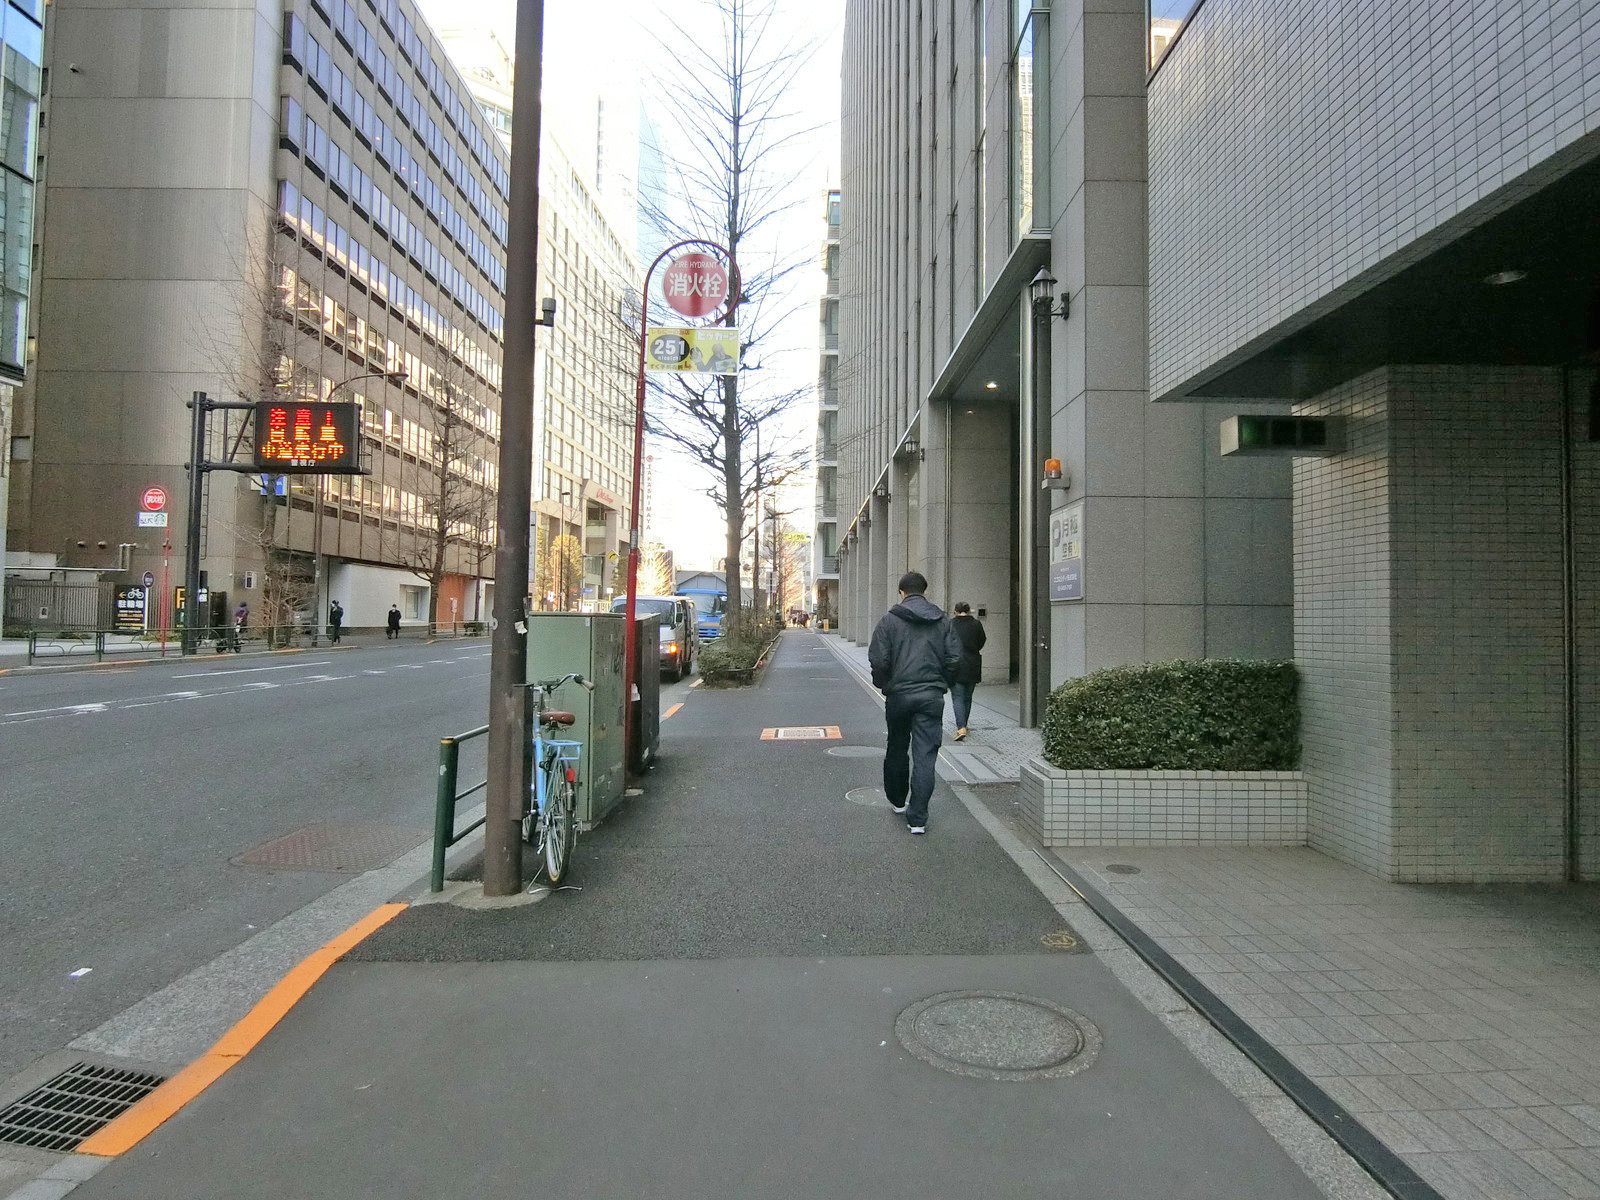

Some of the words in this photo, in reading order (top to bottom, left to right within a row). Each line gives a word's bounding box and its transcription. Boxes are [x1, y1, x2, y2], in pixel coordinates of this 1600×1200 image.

[674, 260, 688, 269] FIRE
[689, 261, 718, 270] HYDRANT
[668, 272, 723, 298] 消火栓
[654, 339, 686, 355] 251
[645, 464, 653, 530] TAKASHIMAYA
